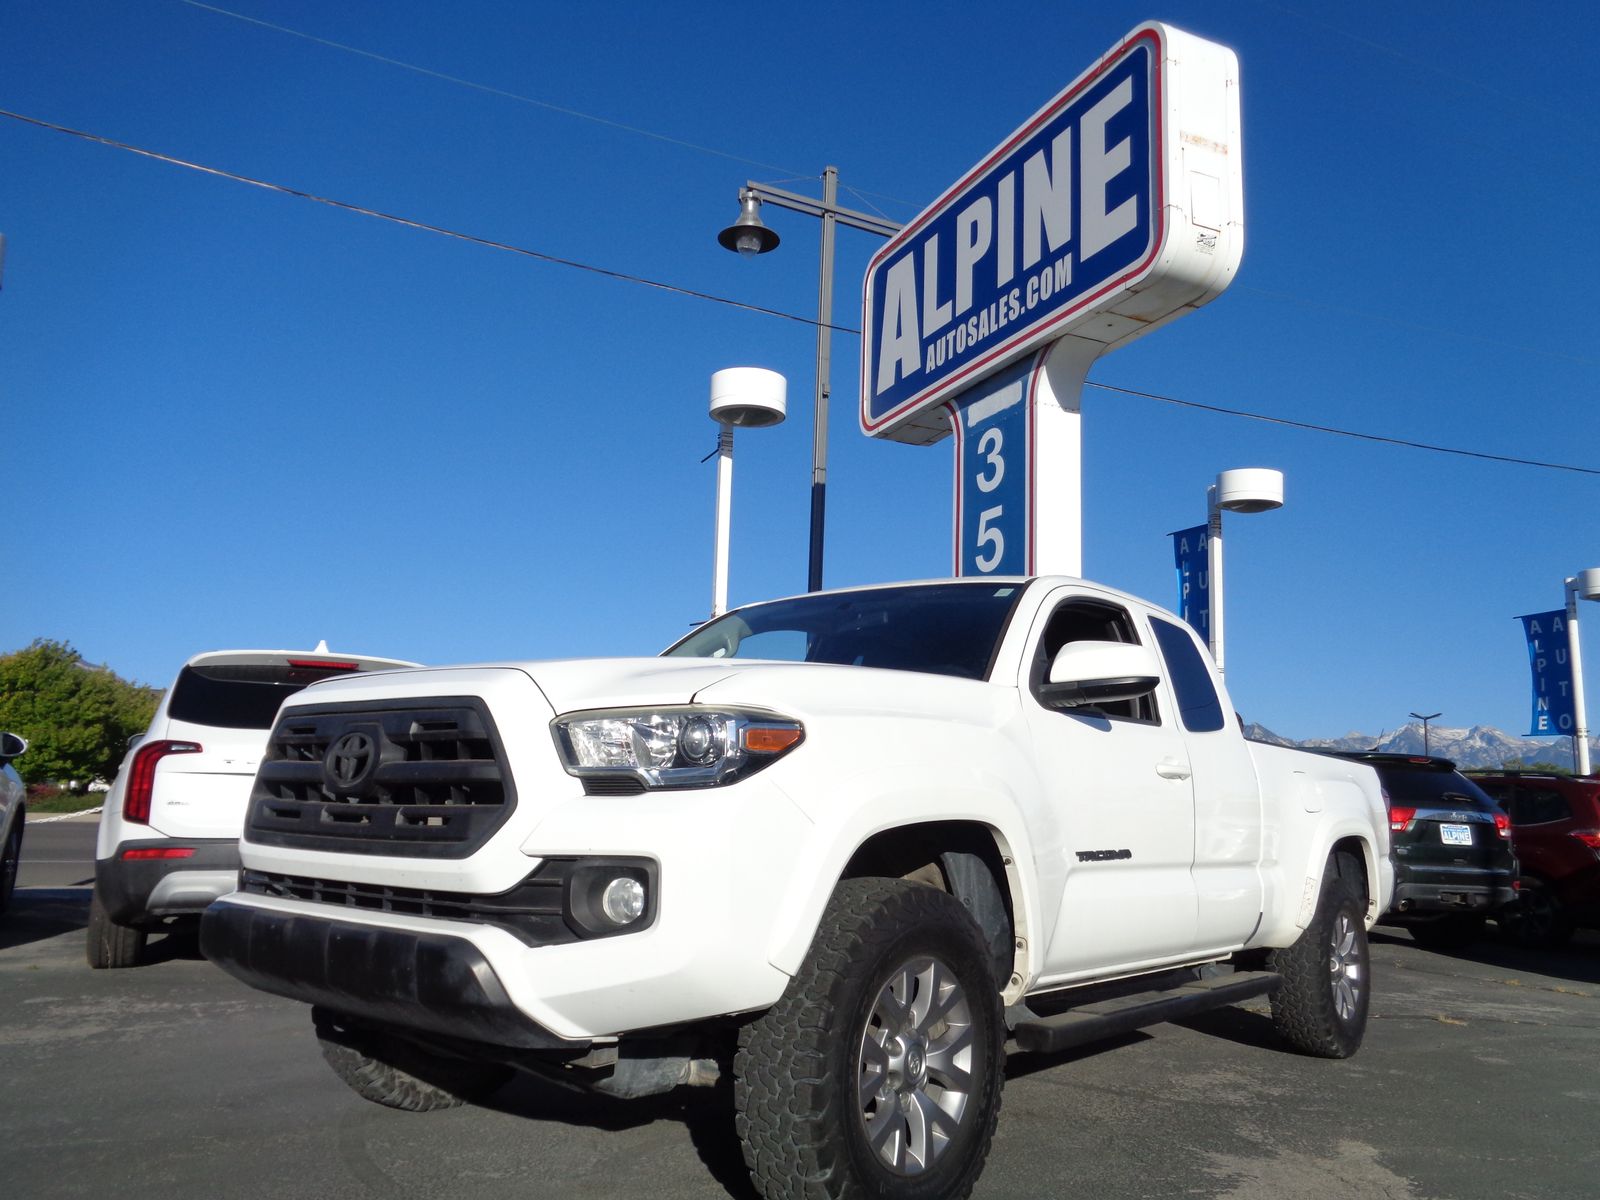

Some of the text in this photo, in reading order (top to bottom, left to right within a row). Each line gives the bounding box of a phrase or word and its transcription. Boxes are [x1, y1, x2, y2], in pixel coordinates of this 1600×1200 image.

[876, 74, 1137, 396] ALPINE
[925, 252, 1072, 374] AUTOSALES.COM
[1530, 619, 1549, 731] ALPINE
[1552, 616, 1572, 730] AUTO
